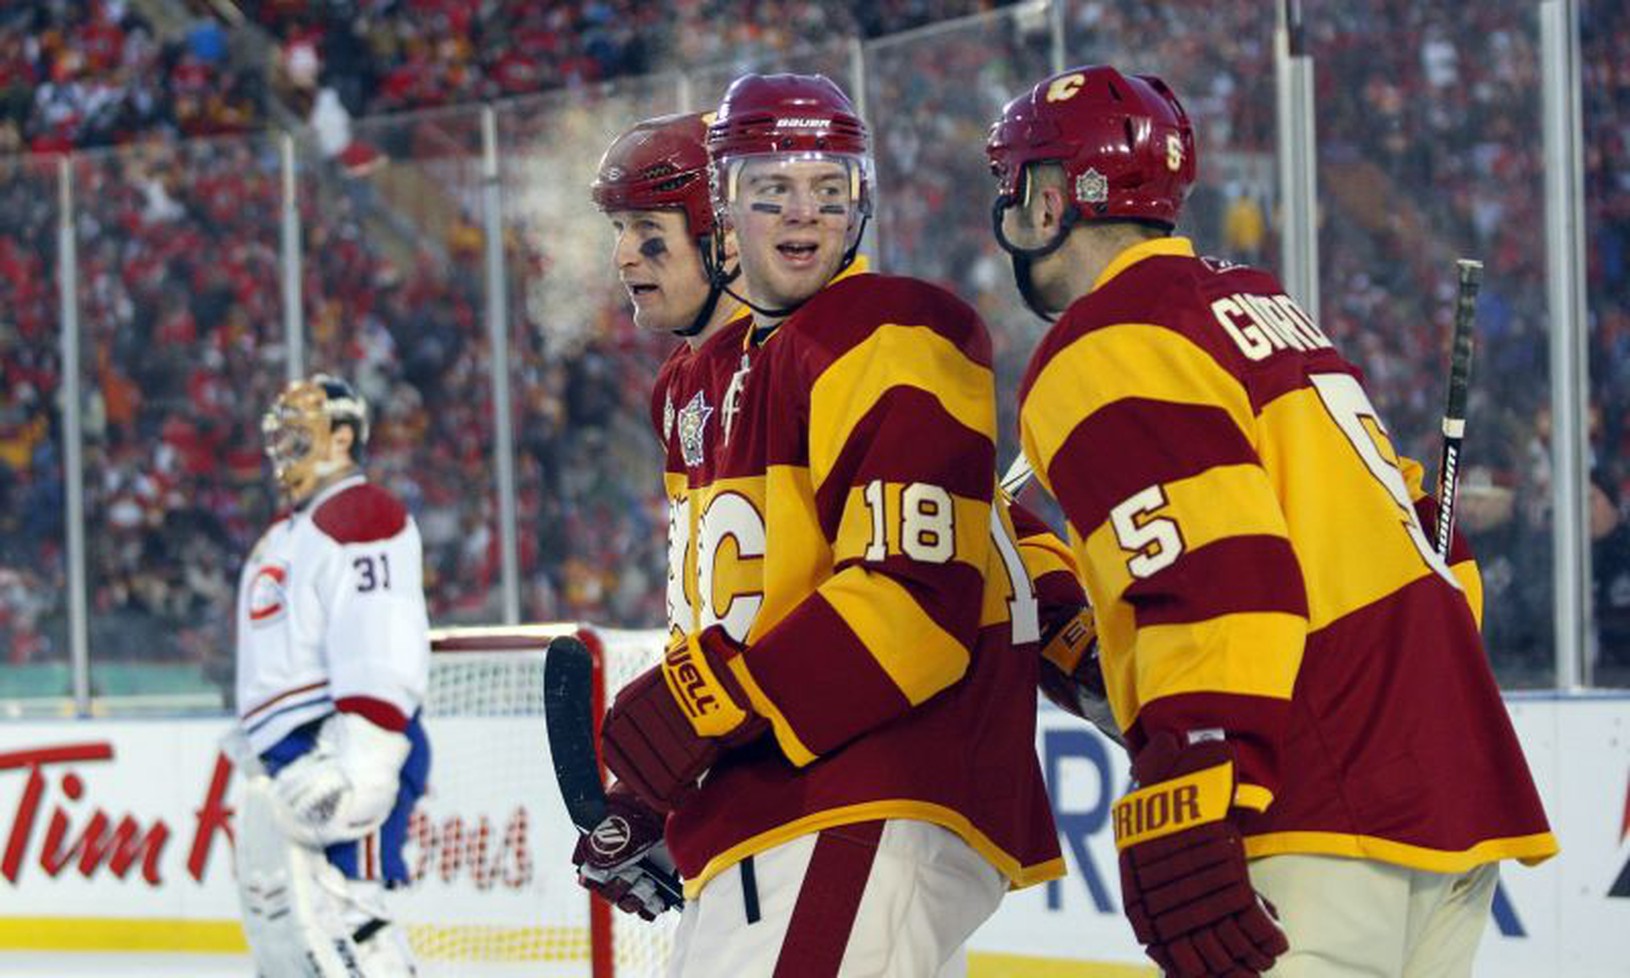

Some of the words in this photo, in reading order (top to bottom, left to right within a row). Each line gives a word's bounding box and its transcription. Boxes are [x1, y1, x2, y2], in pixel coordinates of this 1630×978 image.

[776, 117, 832, 128] BAUER
[864, 479, 957, 564] 18
[1108, 483, 1186, 579] 5
[353, 553, 391, 592] 31
[0, 743, 170, 887] Tim
